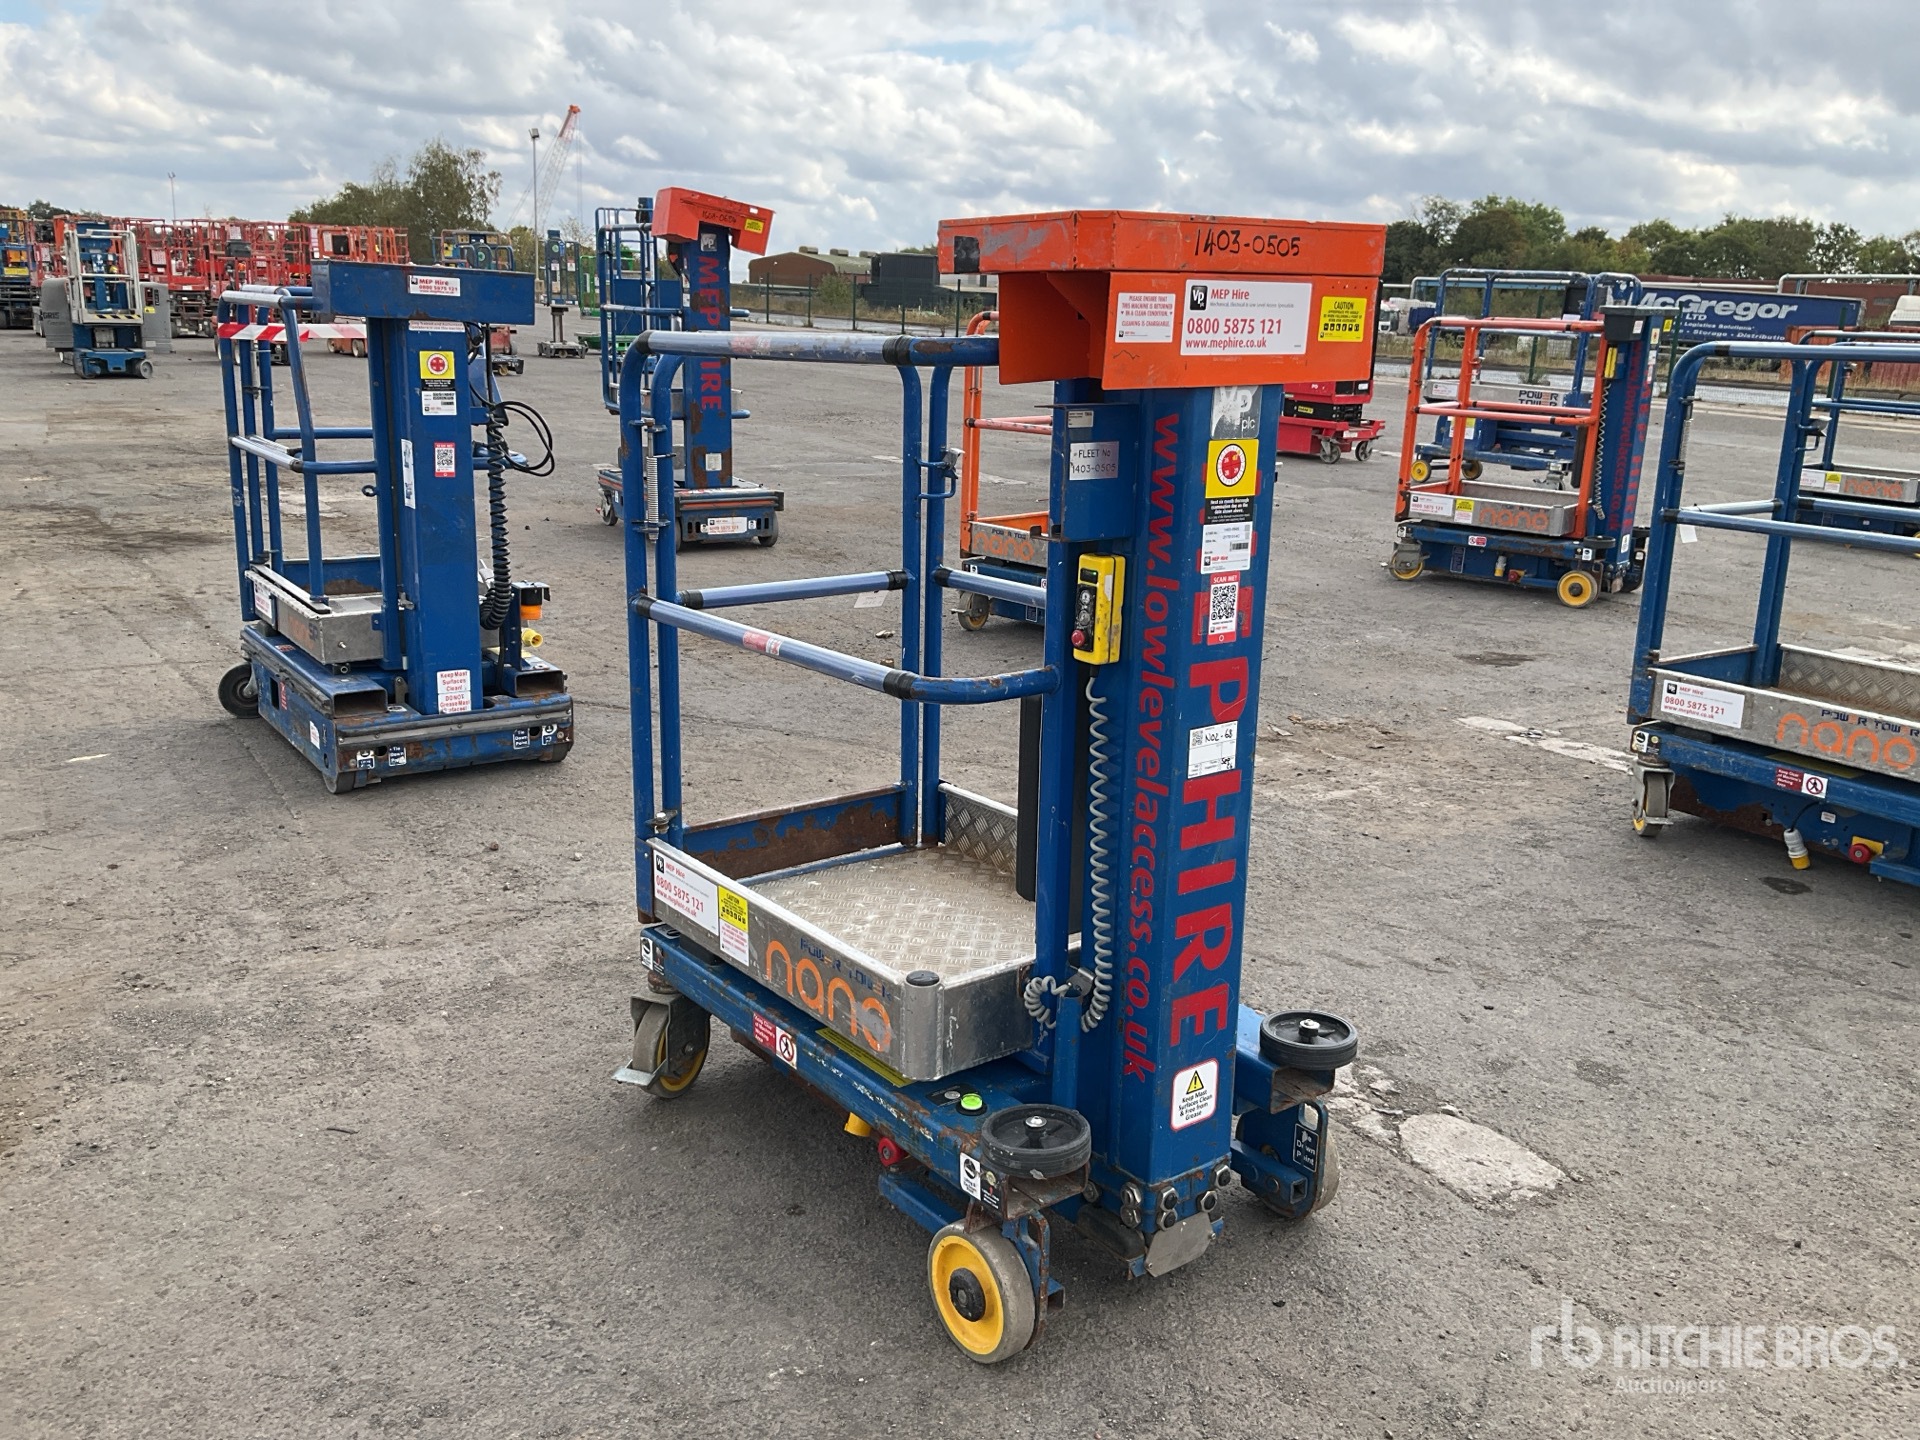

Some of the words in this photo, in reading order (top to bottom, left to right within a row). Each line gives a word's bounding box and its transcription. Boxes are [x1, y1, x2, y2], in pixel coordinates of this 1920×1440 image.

[1195, 228, 1301, 257] 1403-0505
[1192, 289, 1205, 305] Vp
[1210, 288, 1230, 300] MEP
[1232, 289, 1250, 300] Hire
[1334, 302, 1354, 310] CAUTION
[1637, 292, 1799, 321] McGregor
[1187, 318, 1220, 334] 0800
[1223, 318, 1255, 335] 5875
[1260, 318, 1282, 335] 121
[1186, 337, 1266, 350] www.mephire.co.uk
[1736, 332, 1786, 342] Distributio
[700, 360, 722, 410] IRE
[1518, 390, 1558, 400] POWER
[1242, 416, 1255, 429] plc
[1078, 448, 1100, 458] FLEET
[1072, 464, 1116, 474] 1403-0505
[1844, 478, 1904, 500] nano
[1479, 506, 1549, 531] nano
[974, 531, 1034, 562] nano
[1664, 696, 1684, 706] 0800
[1686, 700, 1708, 711] 5875
[1710, 706, 1724, 715] 121
[1664, 704, 1714, 719] www.mephire.co.uk
[1821, 709, 1868, 726] POWER
[1874, 720, 1920, 737] TOWER
[1122, 413, 1181, 1083] www.lowlevelaccess.co.uk
[1776, 712, 1916, 770] nano
[666, 862, 674, 872] MEP
[676, 868, 686, 878] Hire
[656, 875, 672, 892] 0800
[674, 885, 690, 904] 5875
[692, 896, 704, 912] 121
[656, 888, 697, 917] www.mephire.co.uk
[1169, 769, 1243, 1048] HIRE
[766, 940, 892, 1052] nano
[1178, 1100, 1198, 1110] Surfaces
[1199, 1094, 1212, 1102] Clean
[1182, 1094, 1194, 1103] Keep
[1194, 1090, 1208, 1098] Mast
[1196, 1102, 1208, 1110] from
[1185, 1111, 1202, 1120] Grease
[1296, 1150, 1314, 1166] Pint
